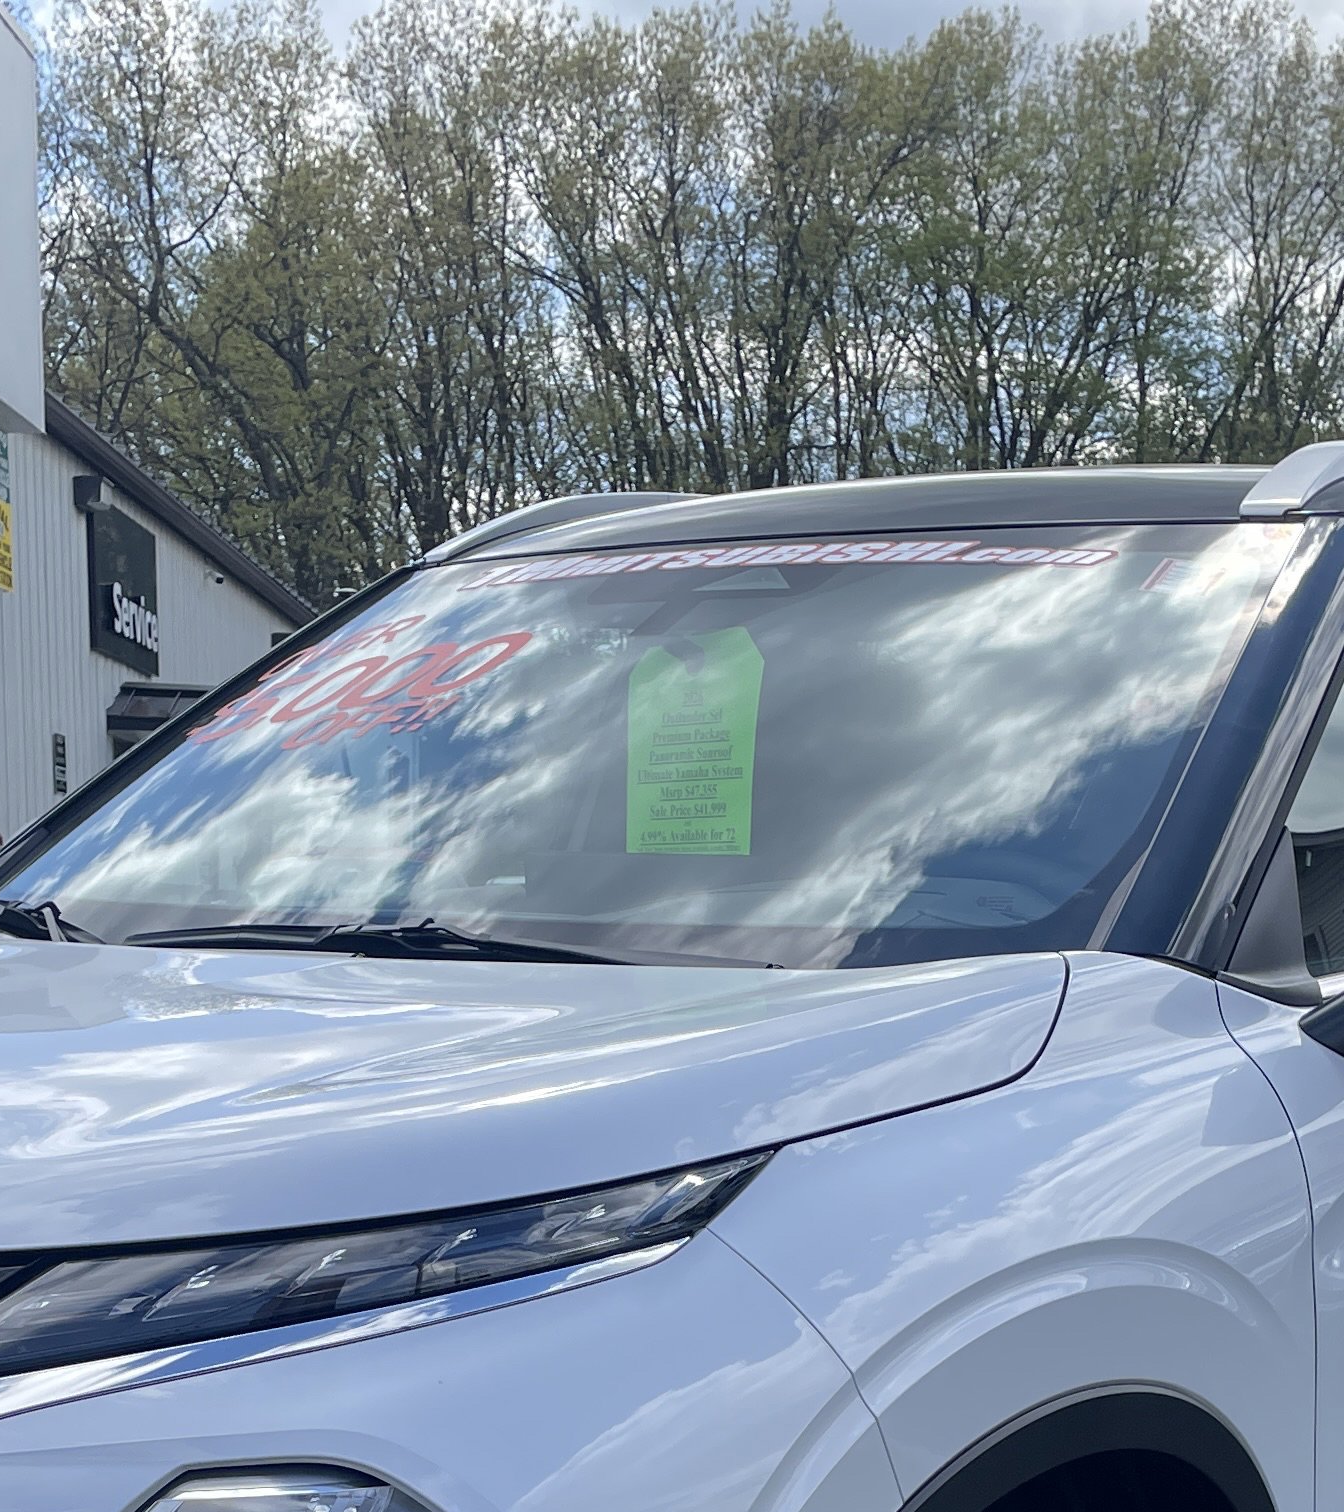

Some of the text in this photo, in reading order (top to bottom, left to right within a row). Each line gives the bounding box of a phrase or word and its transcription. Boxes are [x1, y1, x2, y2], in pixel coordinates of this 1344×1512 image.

[113, 581, 158, 653] Service
[257, 613, 427, 682] OVER
[652, 728, 731, 743] Premium Package
[649, 744, 734, 763] Panoramic Sunroof
[676, 766, 709, 779] Yamaha
[712, 764, 744, 777] System
[660, 786, 683, 799] Msrp
[650, 805, 667, 818] Sale
[670, 804, 692, 817] Price
[671, 828, 709, 842] Available
[711, 828, 724, 841] for
